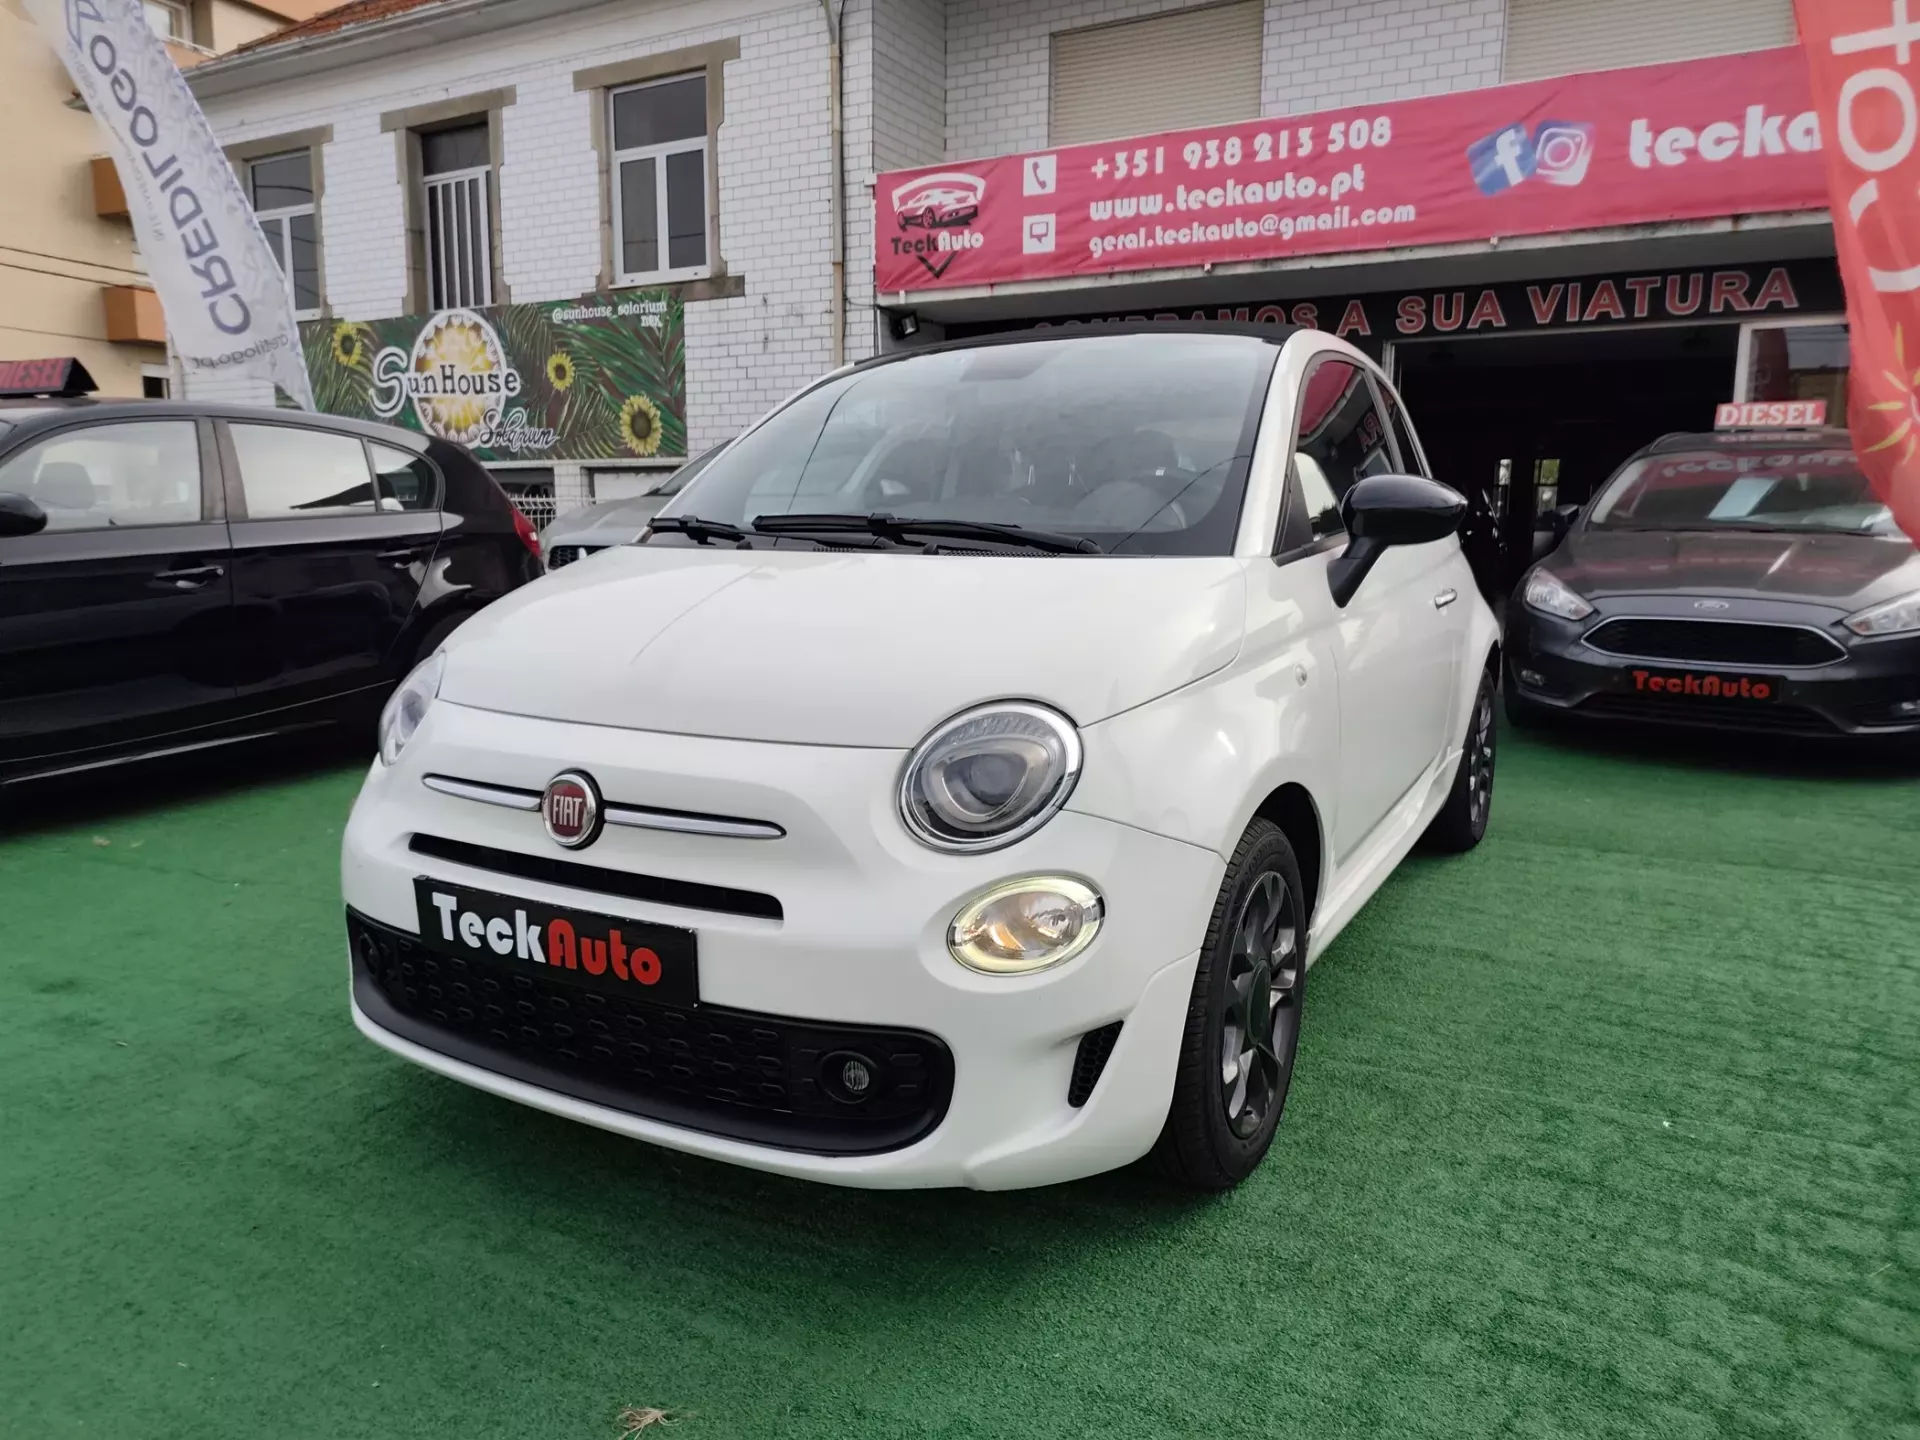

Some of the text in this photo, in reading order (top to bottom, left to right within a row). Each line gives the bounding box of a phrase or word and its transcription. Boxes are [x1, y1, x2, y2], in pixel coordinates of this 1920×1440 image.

[1091, 115, 1392, 180] +351 938 213 508
[1089, 162, 1365, 221] www.teckauto.pt
[891, 229, 984, 255] TeckAuto
[1089, 203, 1417, 259] geral.teckauto@gmail.com
[552, 301, 667, 325] @sunhouse_solarium
[1335, 300, 1372, 336] A
[1395, 289, 1507, 334] SUA
[1526, 267, 1799, 324] VIATURA
[368, 346, 522, 418] SunHouse
[479, 406, 561, 453] Solarium
[1718, 403, 1822, 426] DIESEL
[1632, 670, 1770, 699] TeckAuto
[552, 795, 583, 828] FIAT
[432, 891, 662, 985] TeckAuto
